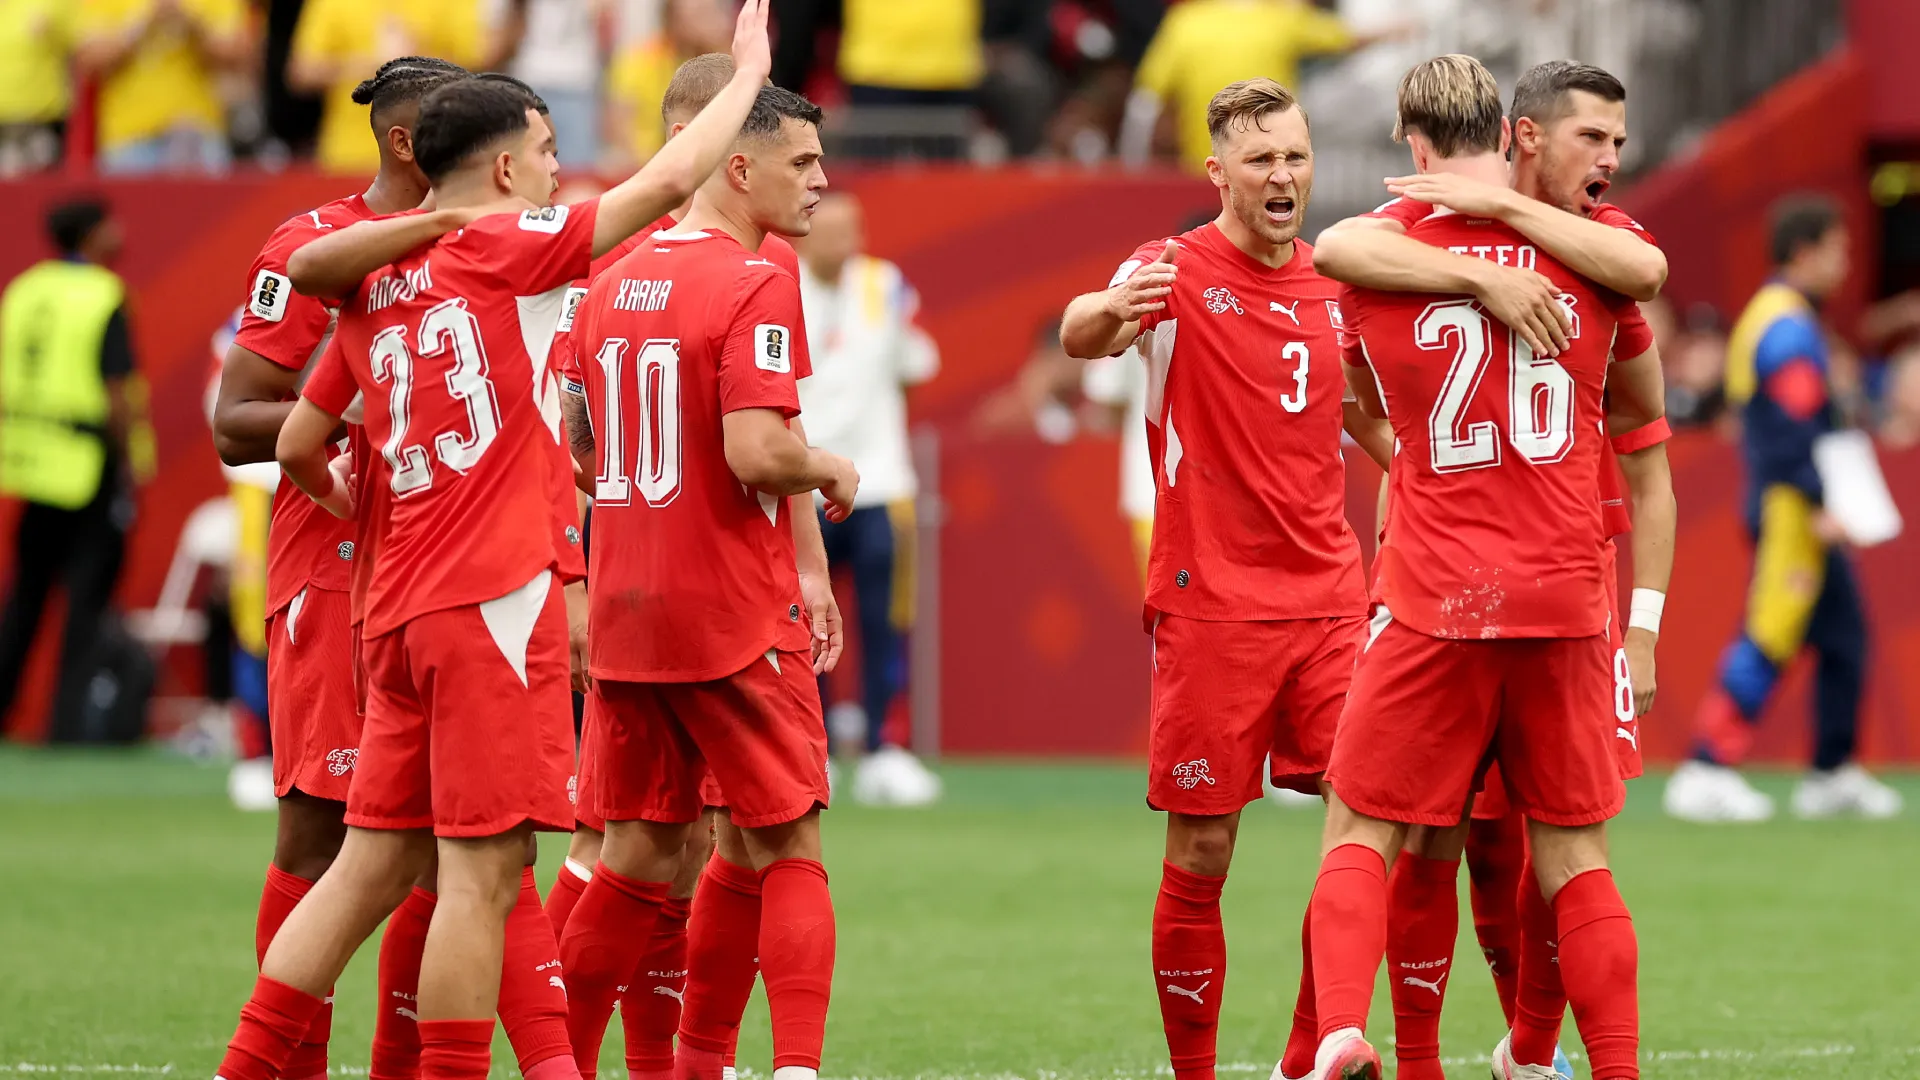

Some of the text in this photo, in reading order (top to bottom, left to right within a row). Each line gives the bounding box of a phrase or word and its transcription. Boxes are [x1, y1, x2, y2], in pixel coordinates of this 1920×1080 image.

[613, 278, 673, 312] XHAKA
[369, 296, 503, 499] 23
[595, 337, 682, 508] 10
[1280, 341, 1310, 413] 3
[1413, 292, 1581, 475] 26
[1613, 648, 1635, 723] 8
